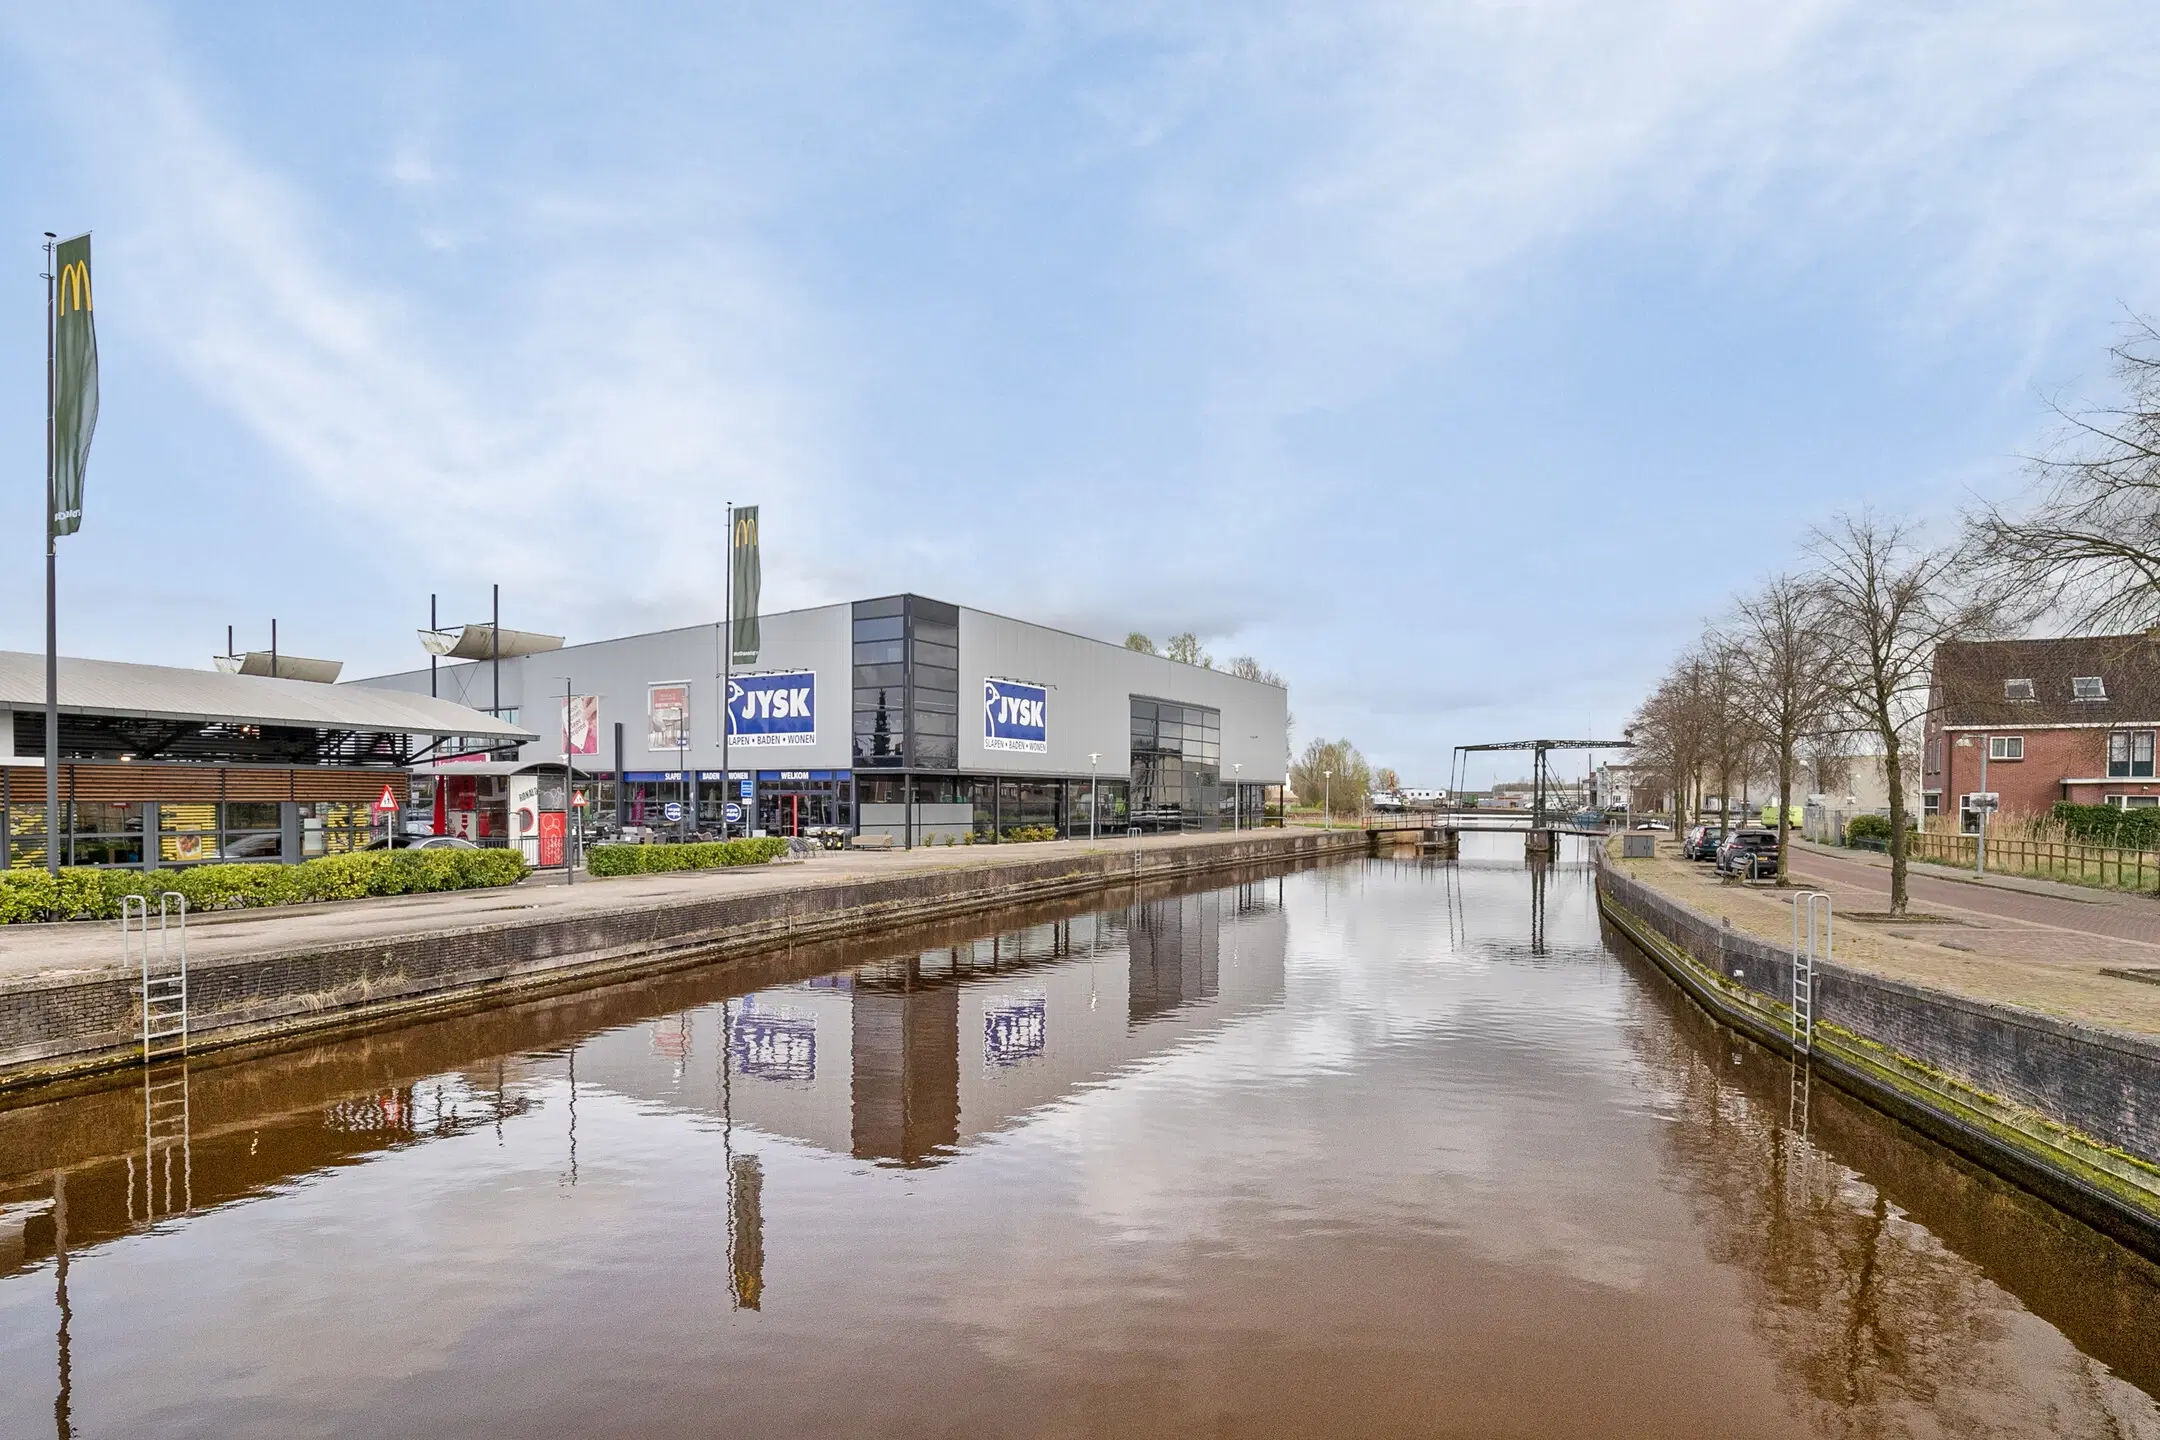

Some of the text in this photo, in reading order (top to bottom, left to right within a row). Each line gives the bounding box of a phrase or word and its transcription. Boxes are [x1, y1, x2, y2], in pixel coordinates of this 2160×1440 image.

[741, 687, 811, 720] JYSK
[997, 696, 1044, 728] JYSK
[728, 734, 815, 746] LAPEN BADEN WONEN
[985, 738, 1046, 752] SLAPEN BADEN WONEN
[702, 772, 720, 780] BADEN
[728, 772, 748, 780] WONEN
[781, 771, 809, 780] WELKOM
